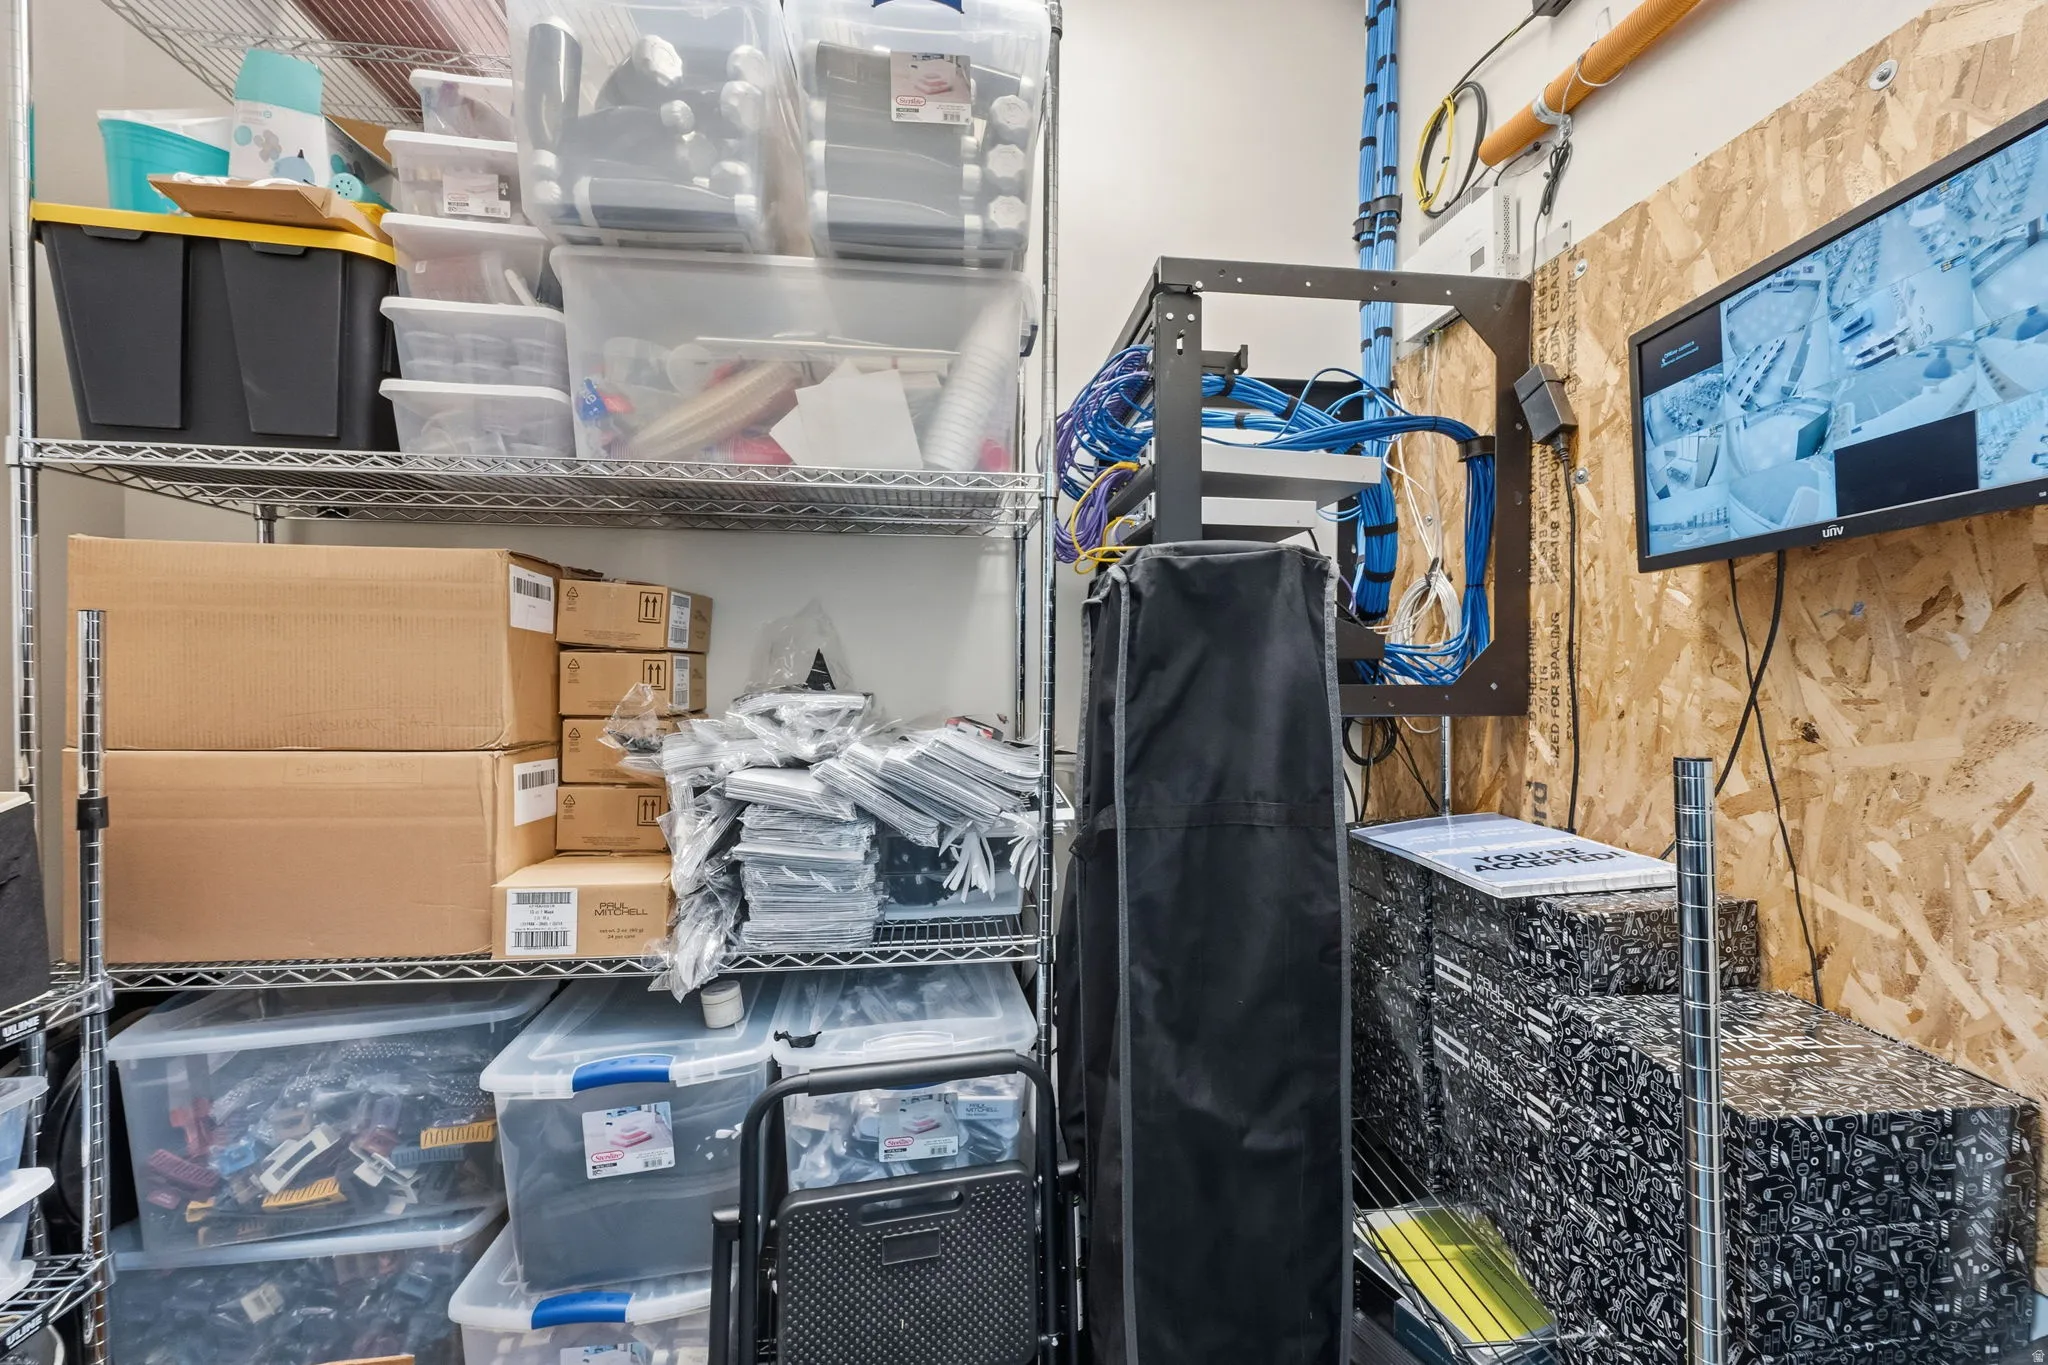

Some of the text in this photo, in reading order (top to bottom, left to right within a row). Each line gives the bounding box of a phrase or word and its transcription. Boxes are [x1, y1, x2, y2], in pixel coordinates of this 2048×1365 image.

[1538, 444, 1548, 525] SHEATHIN
[1550, 611, 1560, 769] SIZED FOR SPACING
[1474, 851, 1624, 872] ACCEPTED!
[594, 908, 648, 916] MITCHELL
[1475, 973, 1505, 998] PAUL
[1472, 980, 1527, 1021] MITCHELL
[1473, 993, 1507, 1018] The School
[2, 1015, 40, 1038] ULINE
[1720, 1035, 1864, 1052] TCHELL
[1474, 1050, 1504, 1079] PAUL
[1720, 1053, 1830, 1067] he School
[1471, 1056, 1526, 1105] MITCHELL
[1471, 1069, 1506, 1100] The School
[6, 1314, 43, 1346] ULINE
